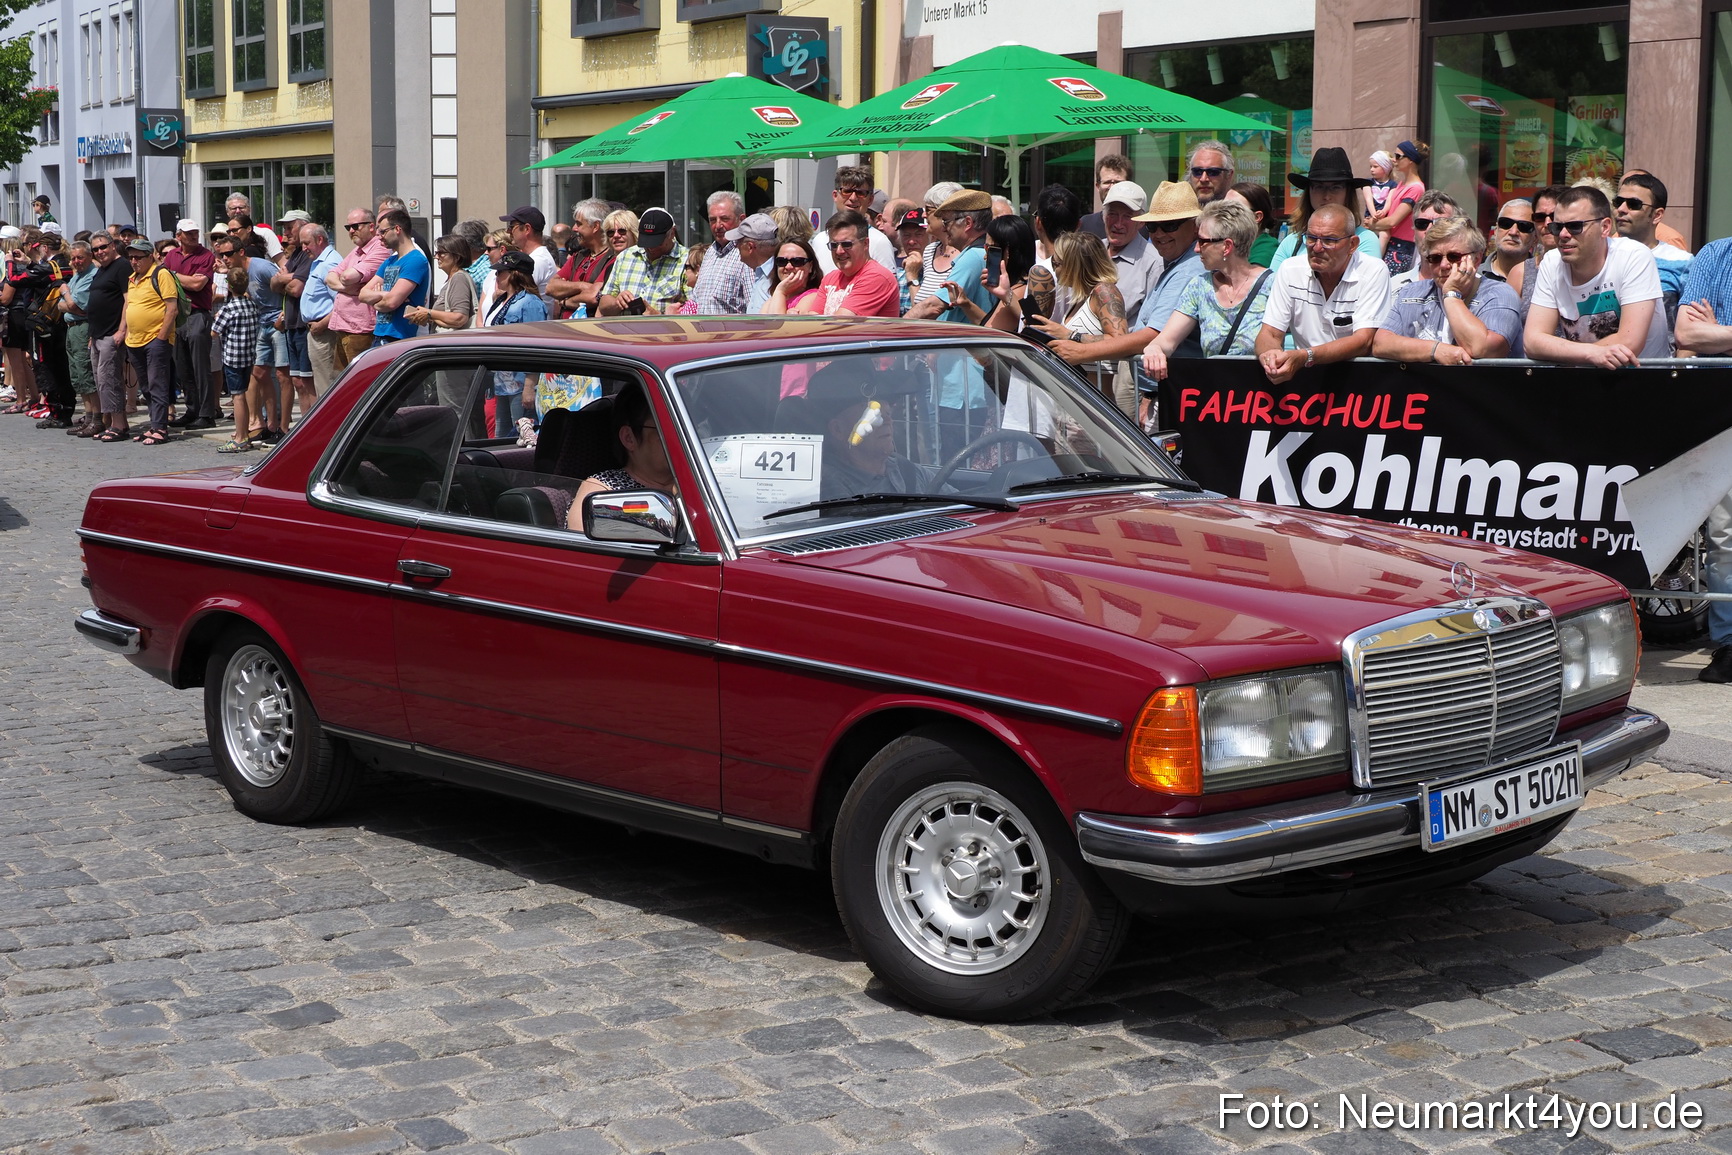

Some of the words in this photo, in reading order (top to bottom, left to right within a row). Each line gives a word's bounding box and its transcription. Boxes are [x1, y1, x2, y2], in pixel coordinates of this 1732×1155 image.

[923, 7, 952, 23] Unterer
[953, 1, 977, 19] Markt
[978, 0, 988, 15] 15
[780, 40, 809, 77] G2
[859, 112, 935, 124] Neumarkter
[1054, 112, 1188, 126] Lammsbräu
[1060, 103, 1154, 114] Neumarkter
[1575, 104, 1619, 120] Grillen
[154, 121, 171, 141] G2
[826, 121, 938, 138] Lammsbräu
[1514, 117, 1542, 131] BURGER
[1179, 388, 1429, 431] FAHRSCHULE
[754, 450, 796, 472] 421
[1239, 429, 1648, 522] Kohlman
[1471, 521, 1578, 550] Freystadt
[1432, 823, 1439, 835] D
[1443, 788, 1477, 835] NM
[1494, 775, 1521, 820] ST
[1528, 757, 1579, 809] 502H
